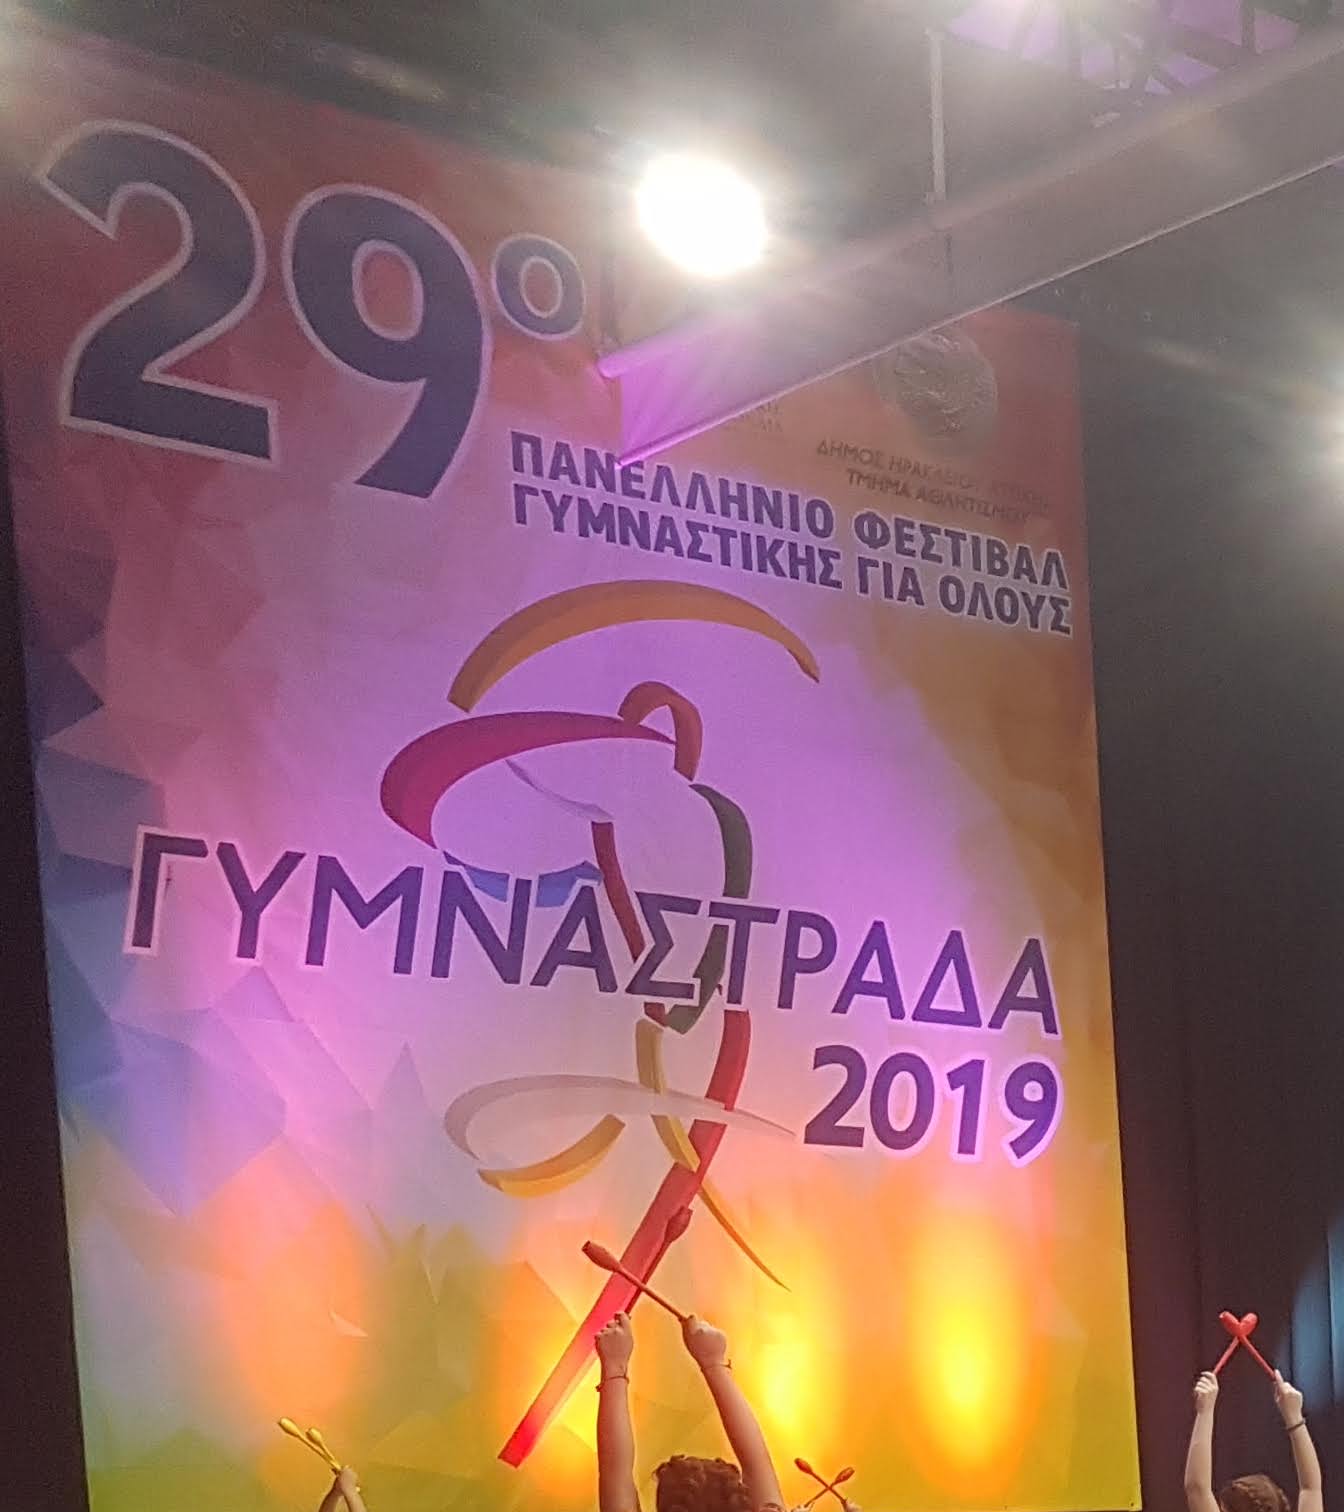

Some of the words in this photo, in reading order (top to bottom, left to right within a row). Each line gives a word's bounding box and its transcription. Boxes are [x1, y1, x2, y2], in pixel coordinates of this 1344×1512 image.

[510, 431, 835, 539] ΠΑΝΕΛΛΗΝΙΟ
[853, 510, 1069, 590] ΦΕΣΤΙΒΑΛ
[512, 483, 843, 590] ΓΥΜΝΑΣΤΙΚΗΣ
[856, 556, 926, 606] ΓΙΑ
[938, 575, 1071, 635] ΟΛΟΥΣ
[845, 467, 911, 499] ΤΜΗΜΑ
[130, 832, 1059, 1035] ΓΥΜΝΑΣΤΡΑΔΑ
[803, 1044, 1059, 1160] 2019
